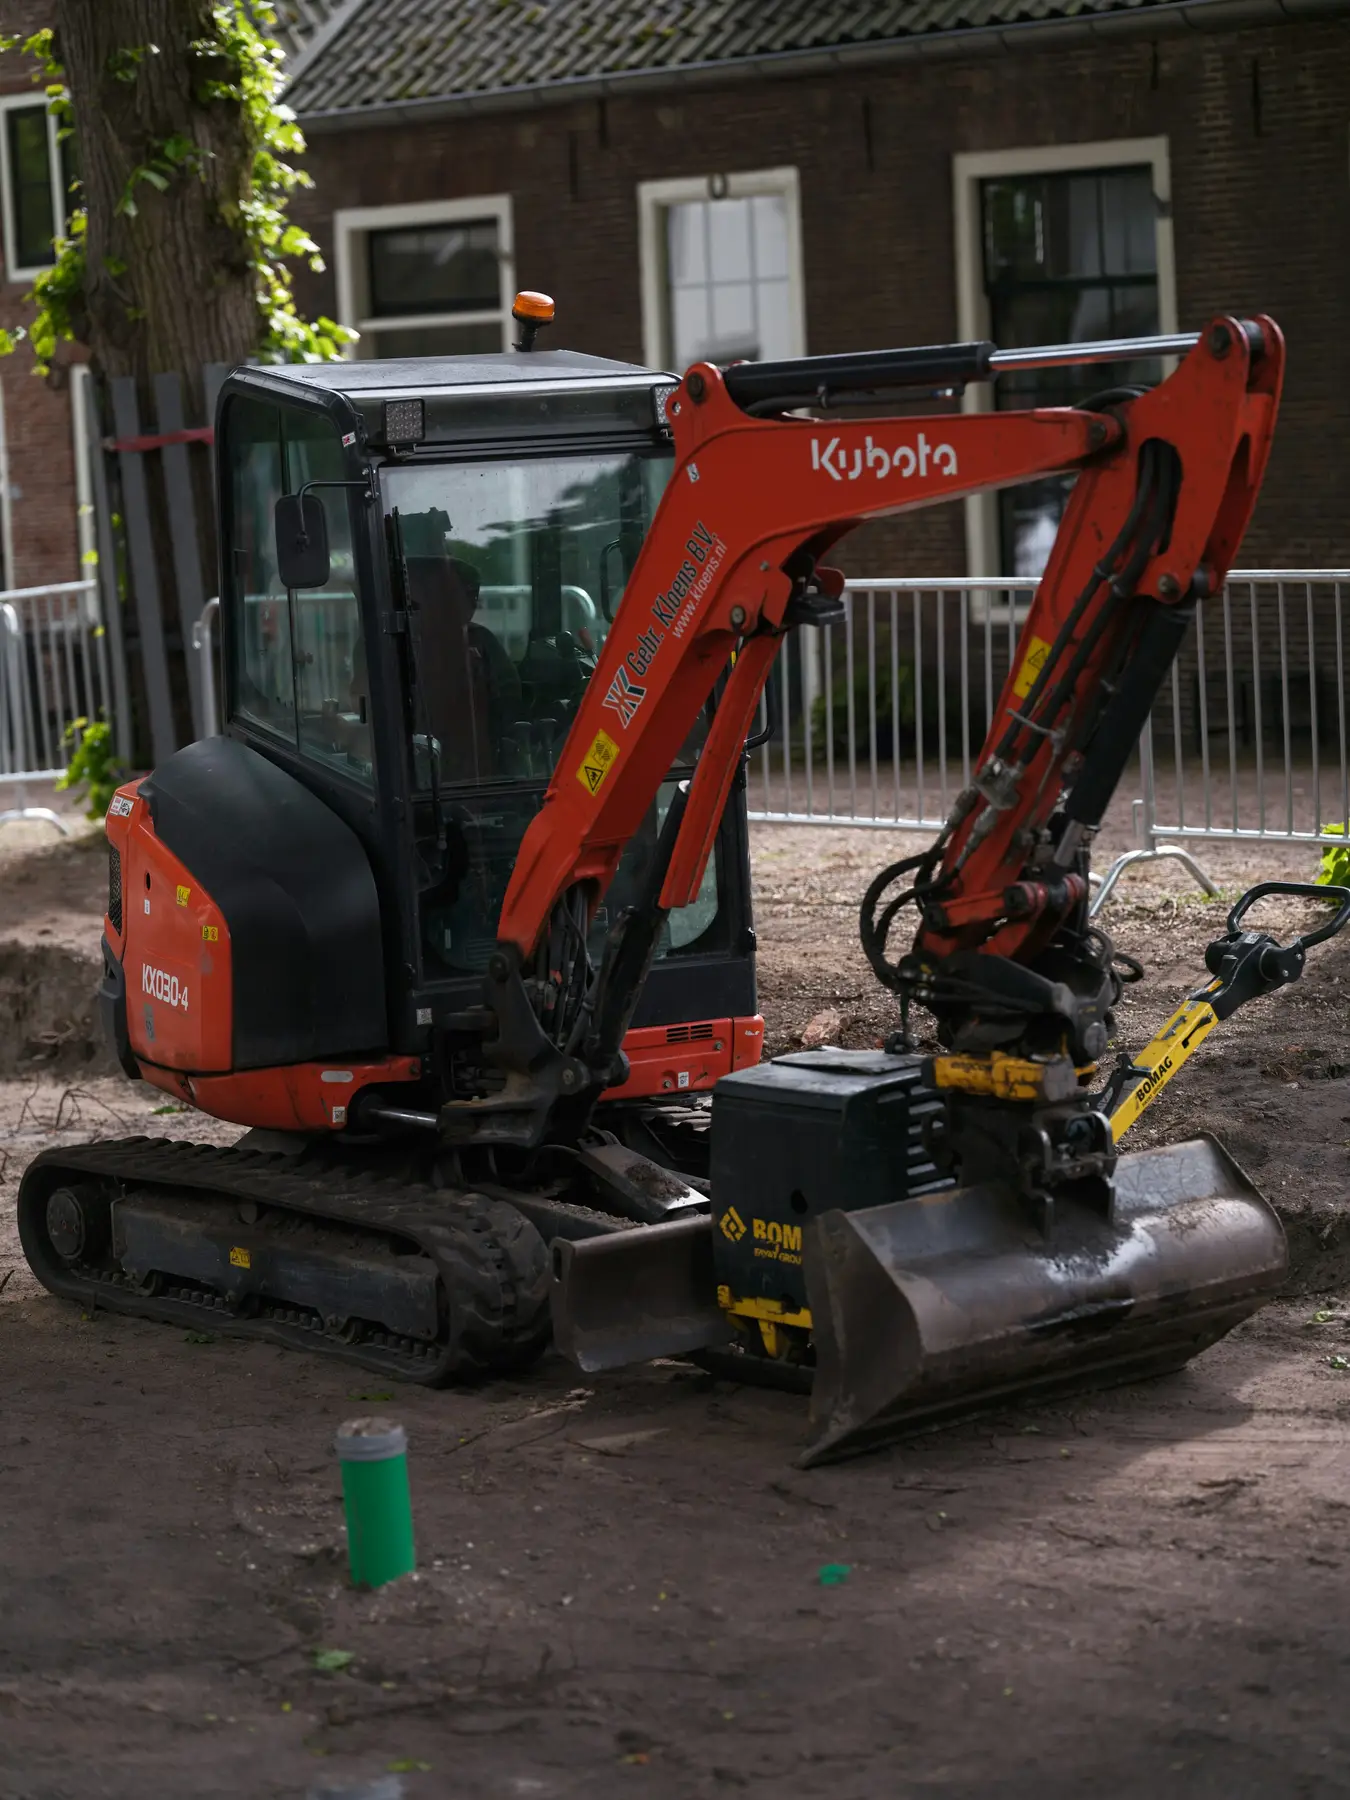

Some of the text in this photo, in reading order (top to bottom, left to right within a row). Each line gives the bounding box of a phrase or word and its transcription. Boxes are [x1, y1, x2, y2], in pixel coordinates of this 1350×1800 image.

[811, 433, 958, 481] Kubota
[626, 520, 718, 678] Gebr. Kloens B.V.
[672, 538, 728, 639] www.kloens.nl
[142, 962, 189, 1012] KX030-4
[1136, 1056, 1173, 1102] BOMAG
